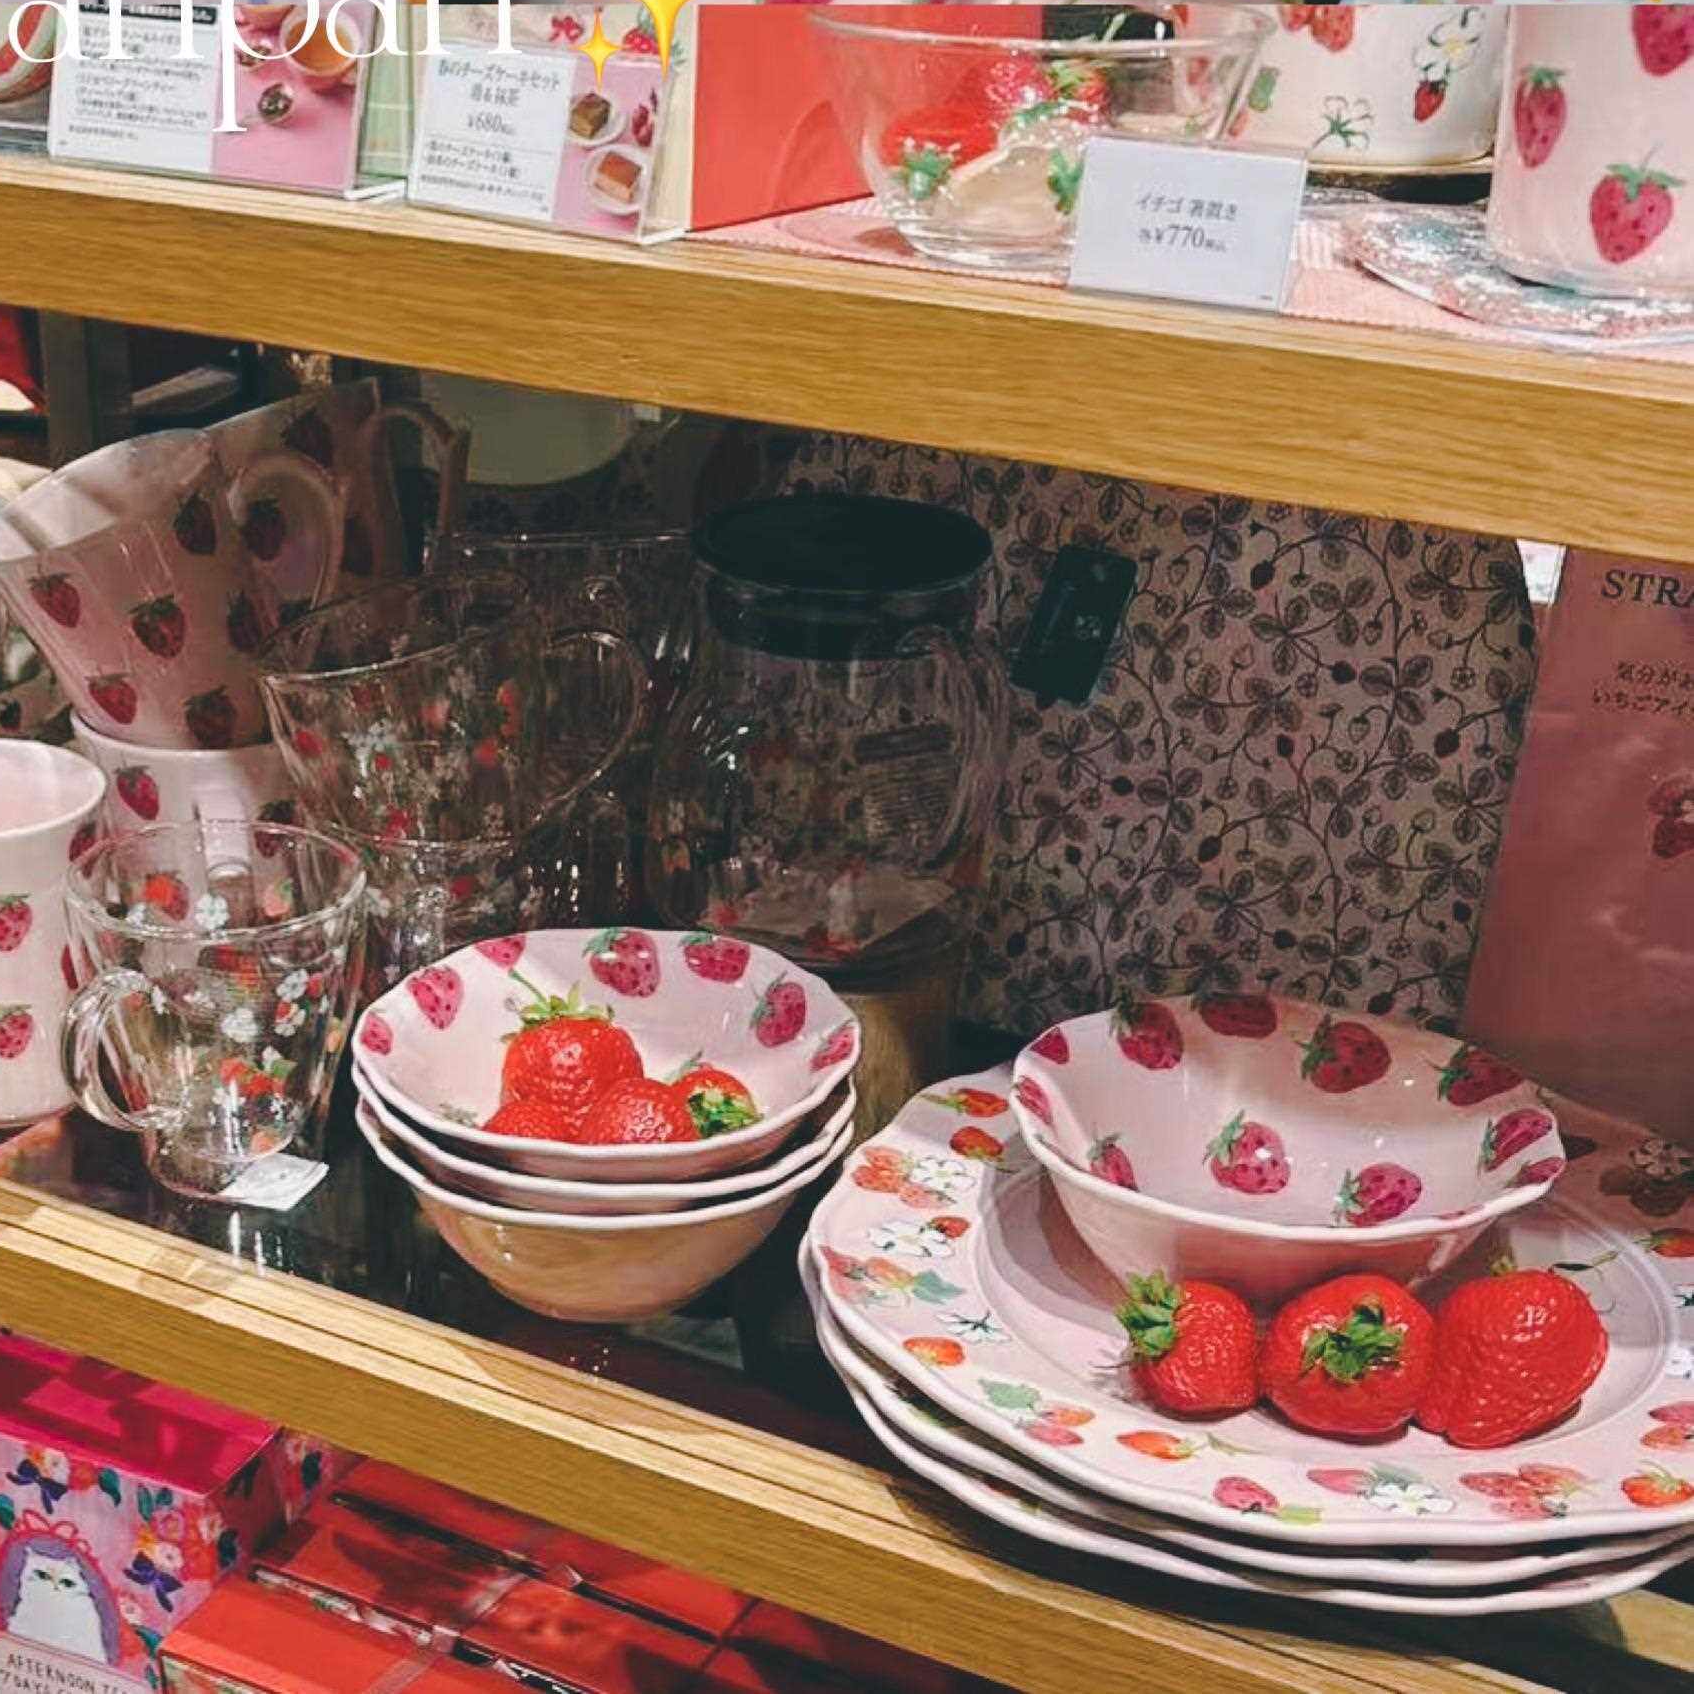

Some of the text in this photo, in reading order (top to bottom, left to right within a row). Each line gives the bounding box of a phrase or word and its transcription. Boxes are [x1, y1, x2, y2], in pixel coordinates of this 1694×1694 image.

[1137, 192, 1185, 215] イチゴ
[7, 1653, 96, 1694] AFTERNOON
